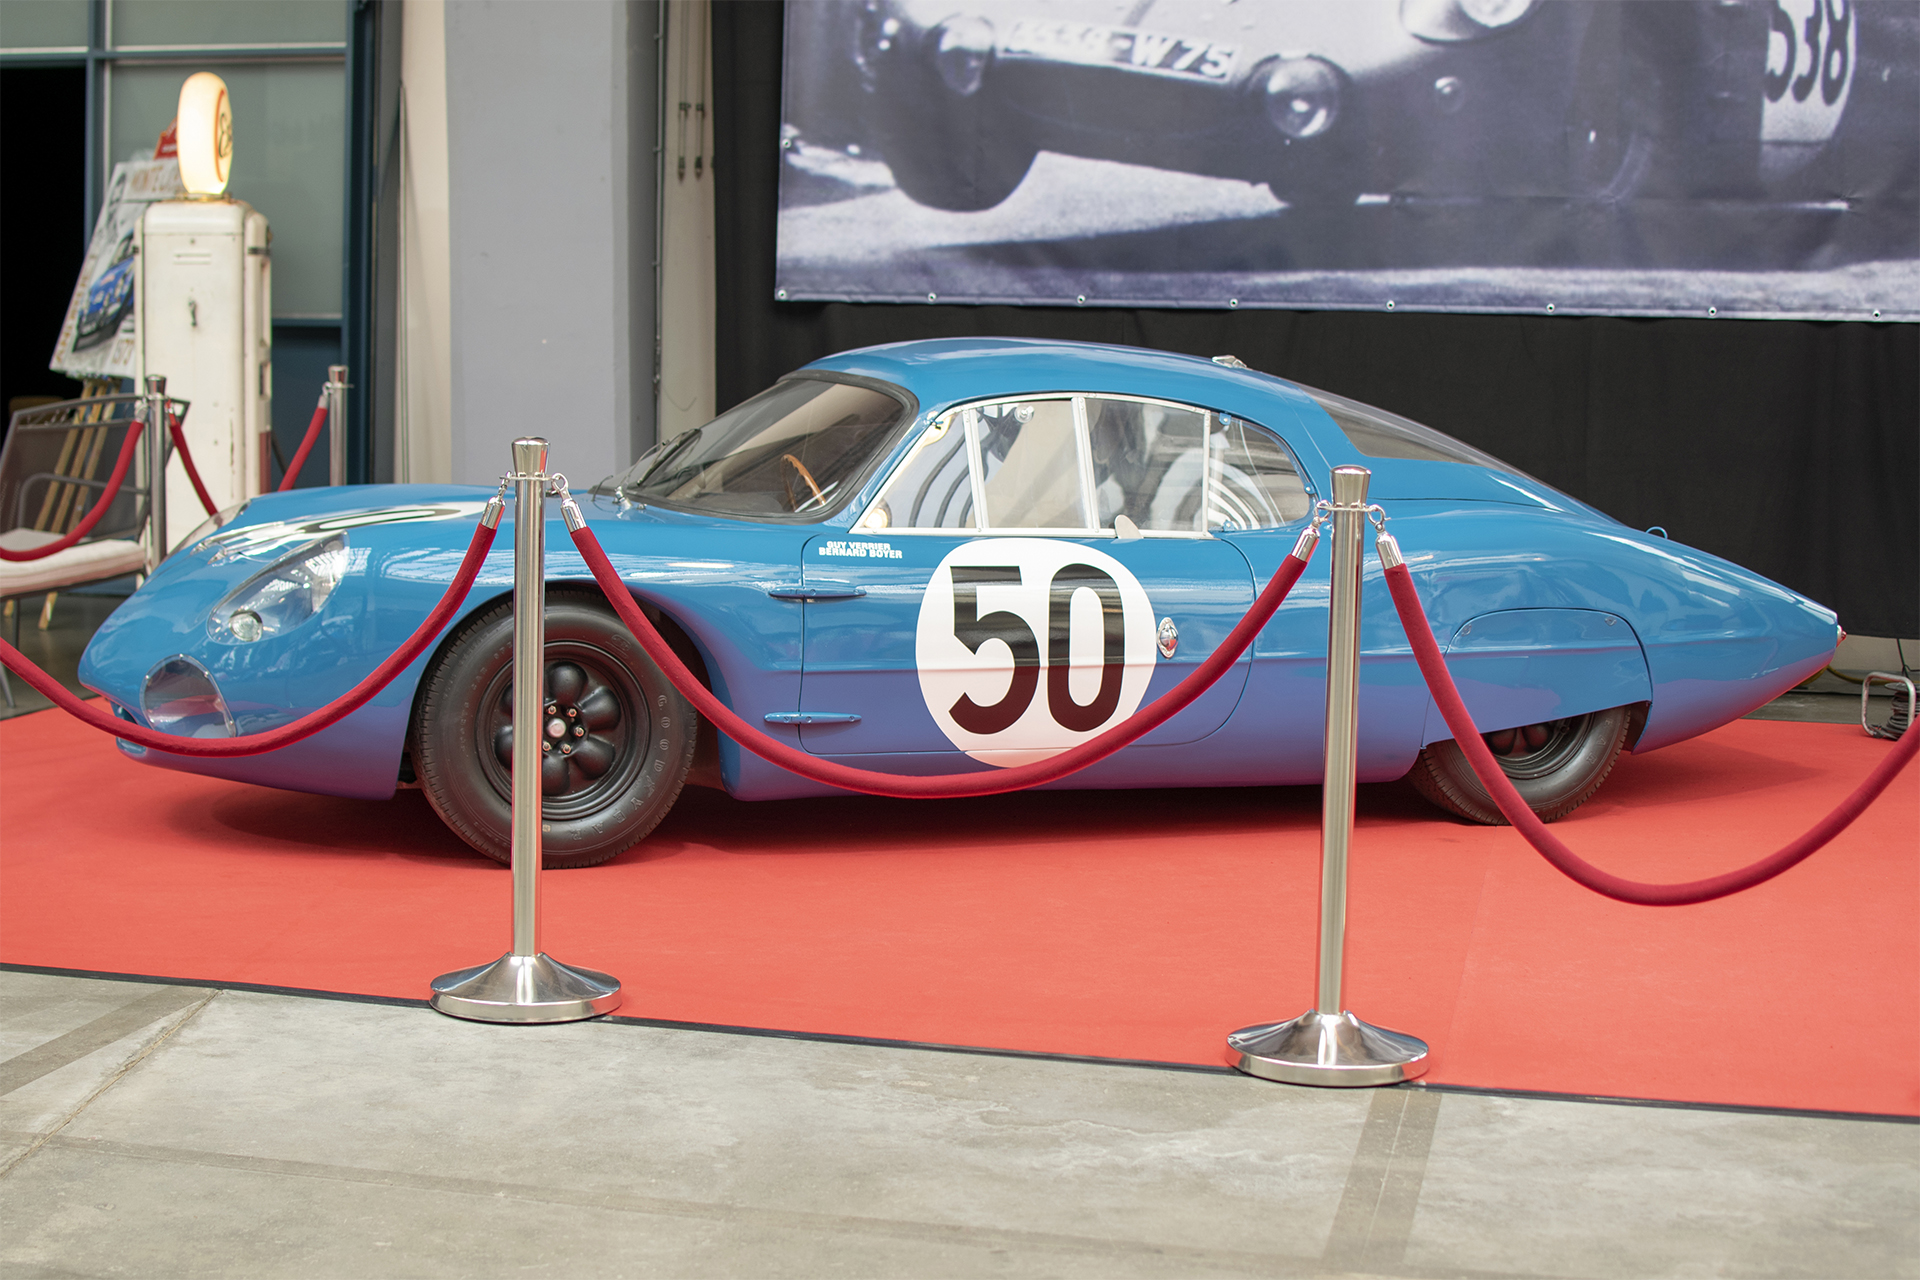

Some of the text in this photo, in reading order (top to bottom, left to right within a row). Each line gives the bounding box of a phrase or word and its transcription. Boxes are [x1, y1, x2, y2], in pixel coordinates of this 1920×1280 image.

[826, 541, 891, 551] GUY VERRIER
[819, 547, 903, 559] BERNARD BOYER
[948, 563, 1125, 735] 50
